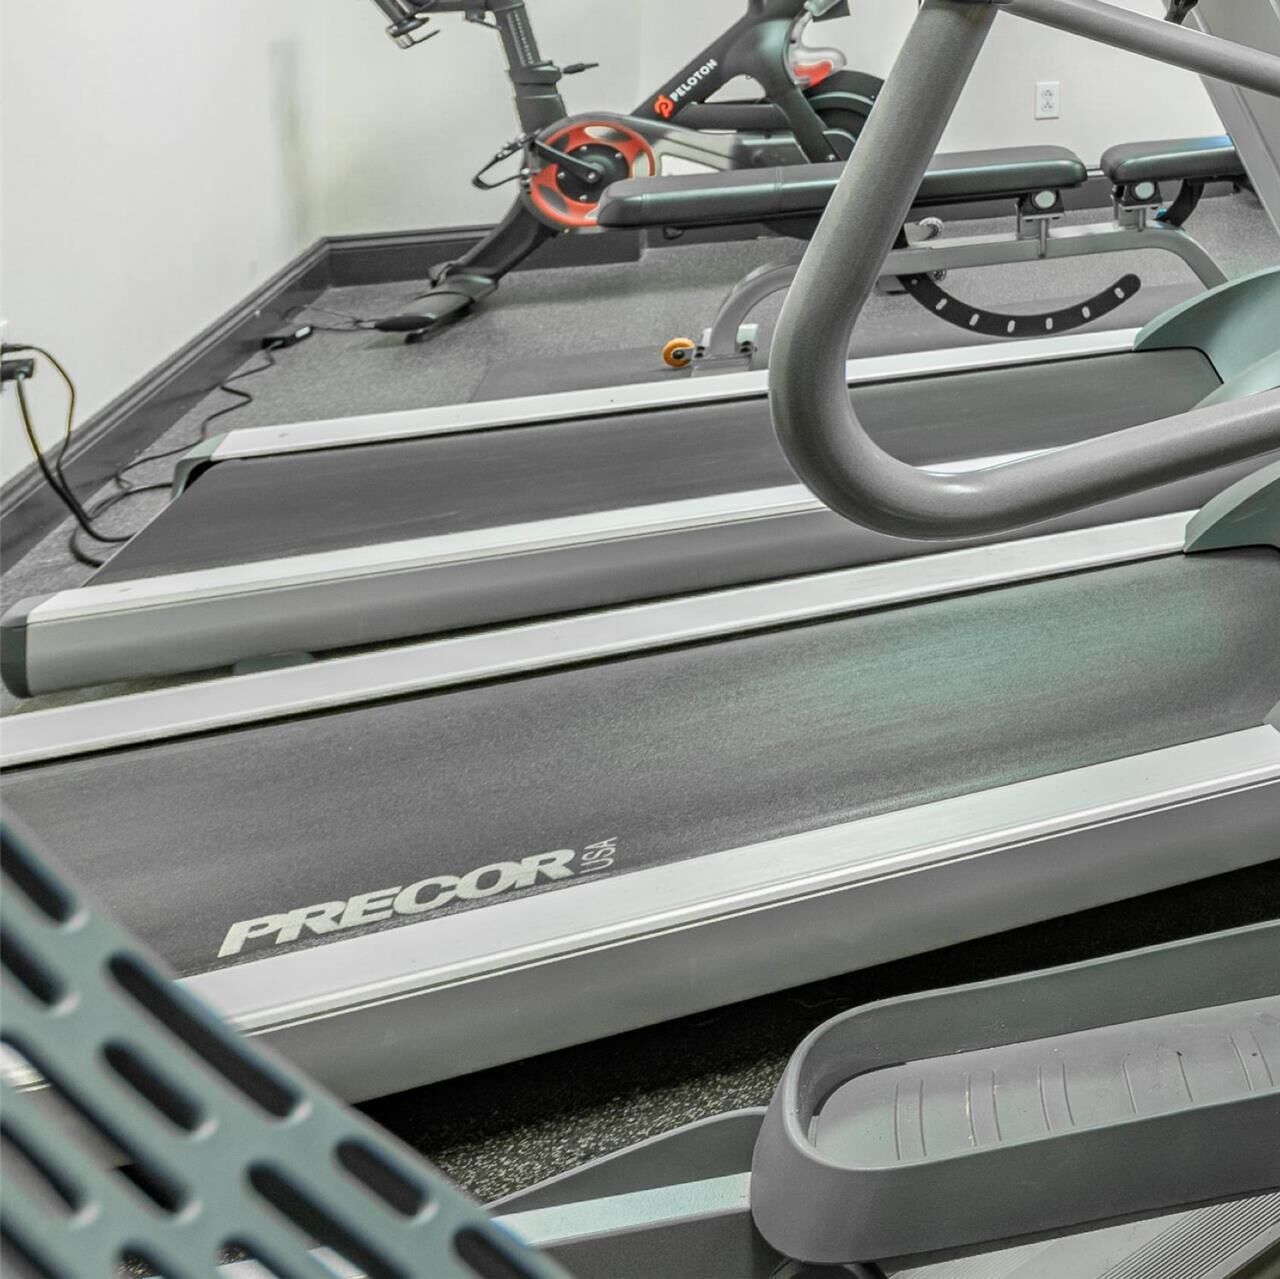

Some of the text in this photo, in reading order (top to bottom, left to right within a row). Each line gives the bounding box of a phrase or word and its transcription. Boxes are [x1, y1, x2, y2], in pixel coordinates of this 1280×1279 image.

[669, 58, 718, 102] PELOTON
[216, 836, 618, 958] PRECOR USA
